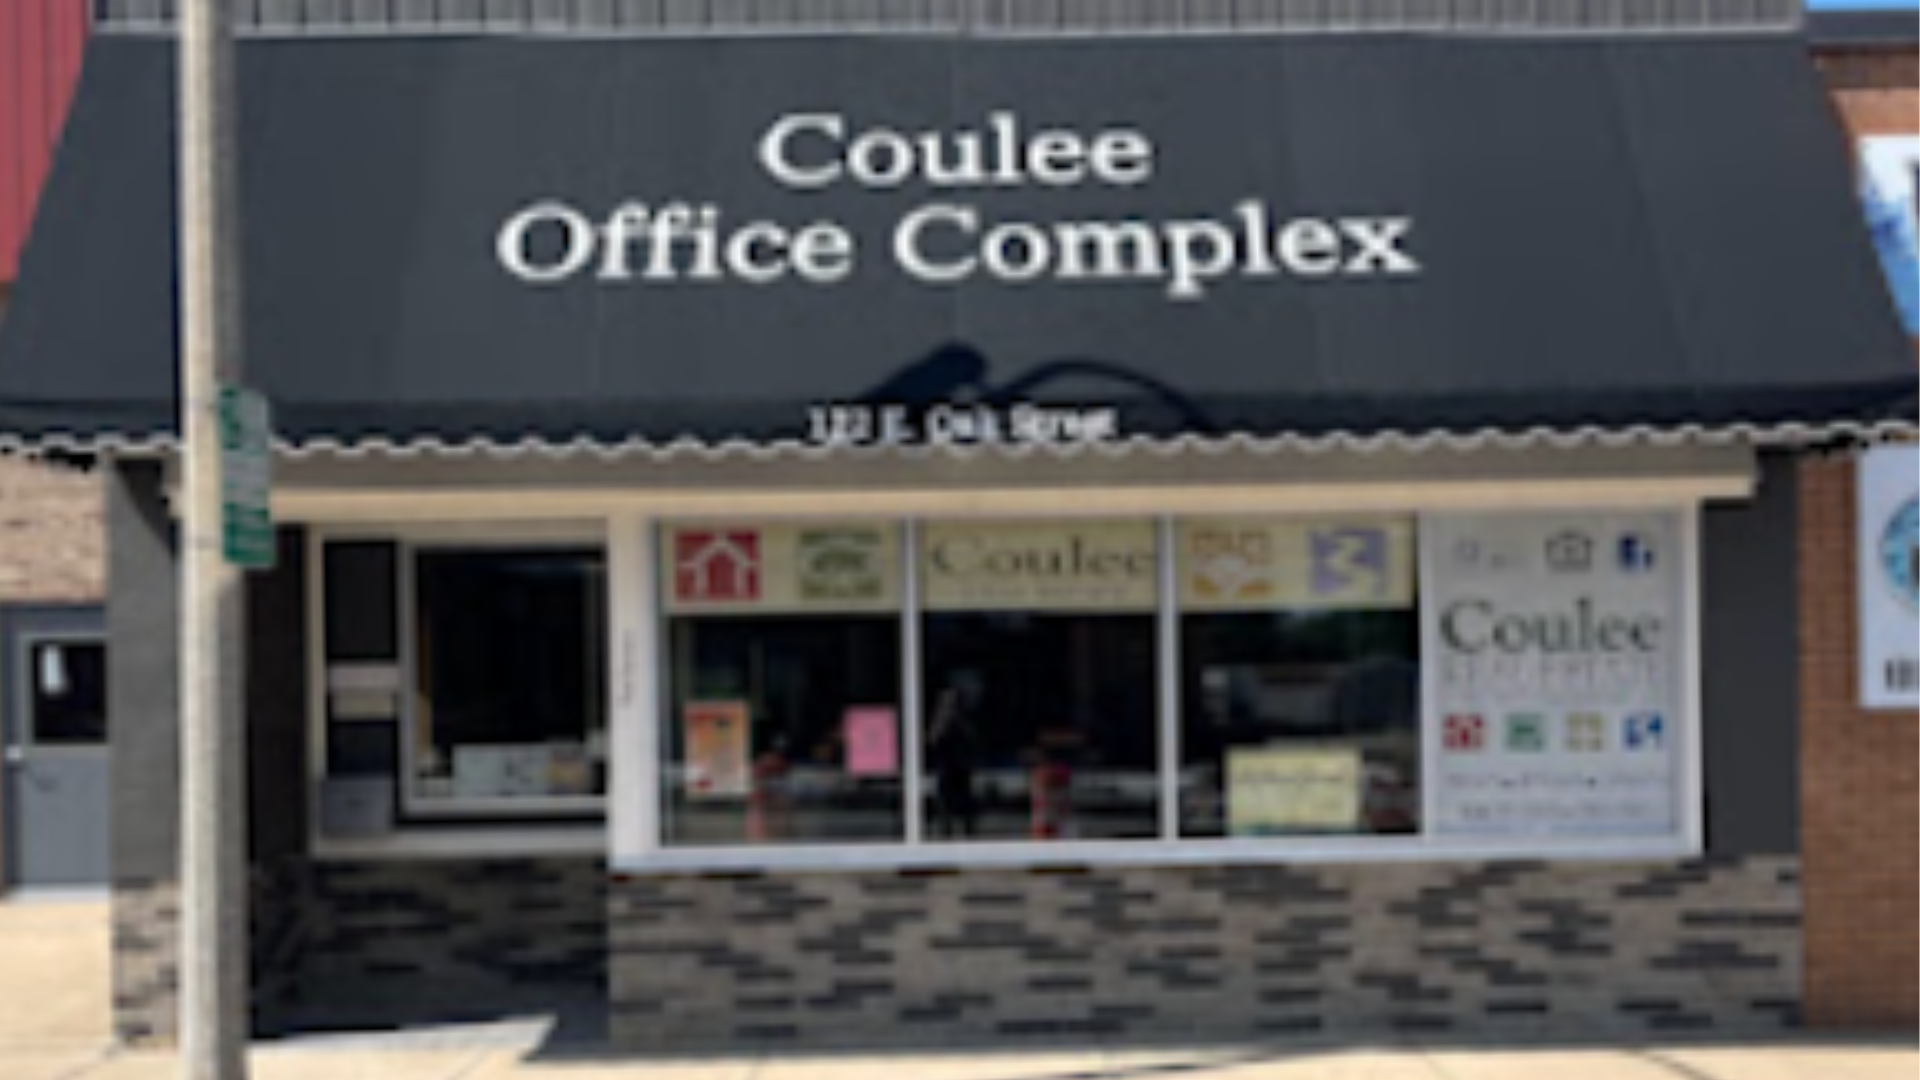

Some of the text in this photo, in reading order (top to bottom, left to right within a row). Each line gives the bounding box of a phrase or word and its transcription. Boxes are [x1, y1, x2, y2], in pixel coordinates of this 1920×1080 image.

[757, 111, 1153, 187] Coulee
[496, 199, 1419, 297] Office Complex
[1009, 403, 1118, 442] Street
[931, 534, 1158, 576] Coulee
[1440, 597, 1663, 655] Coulee
